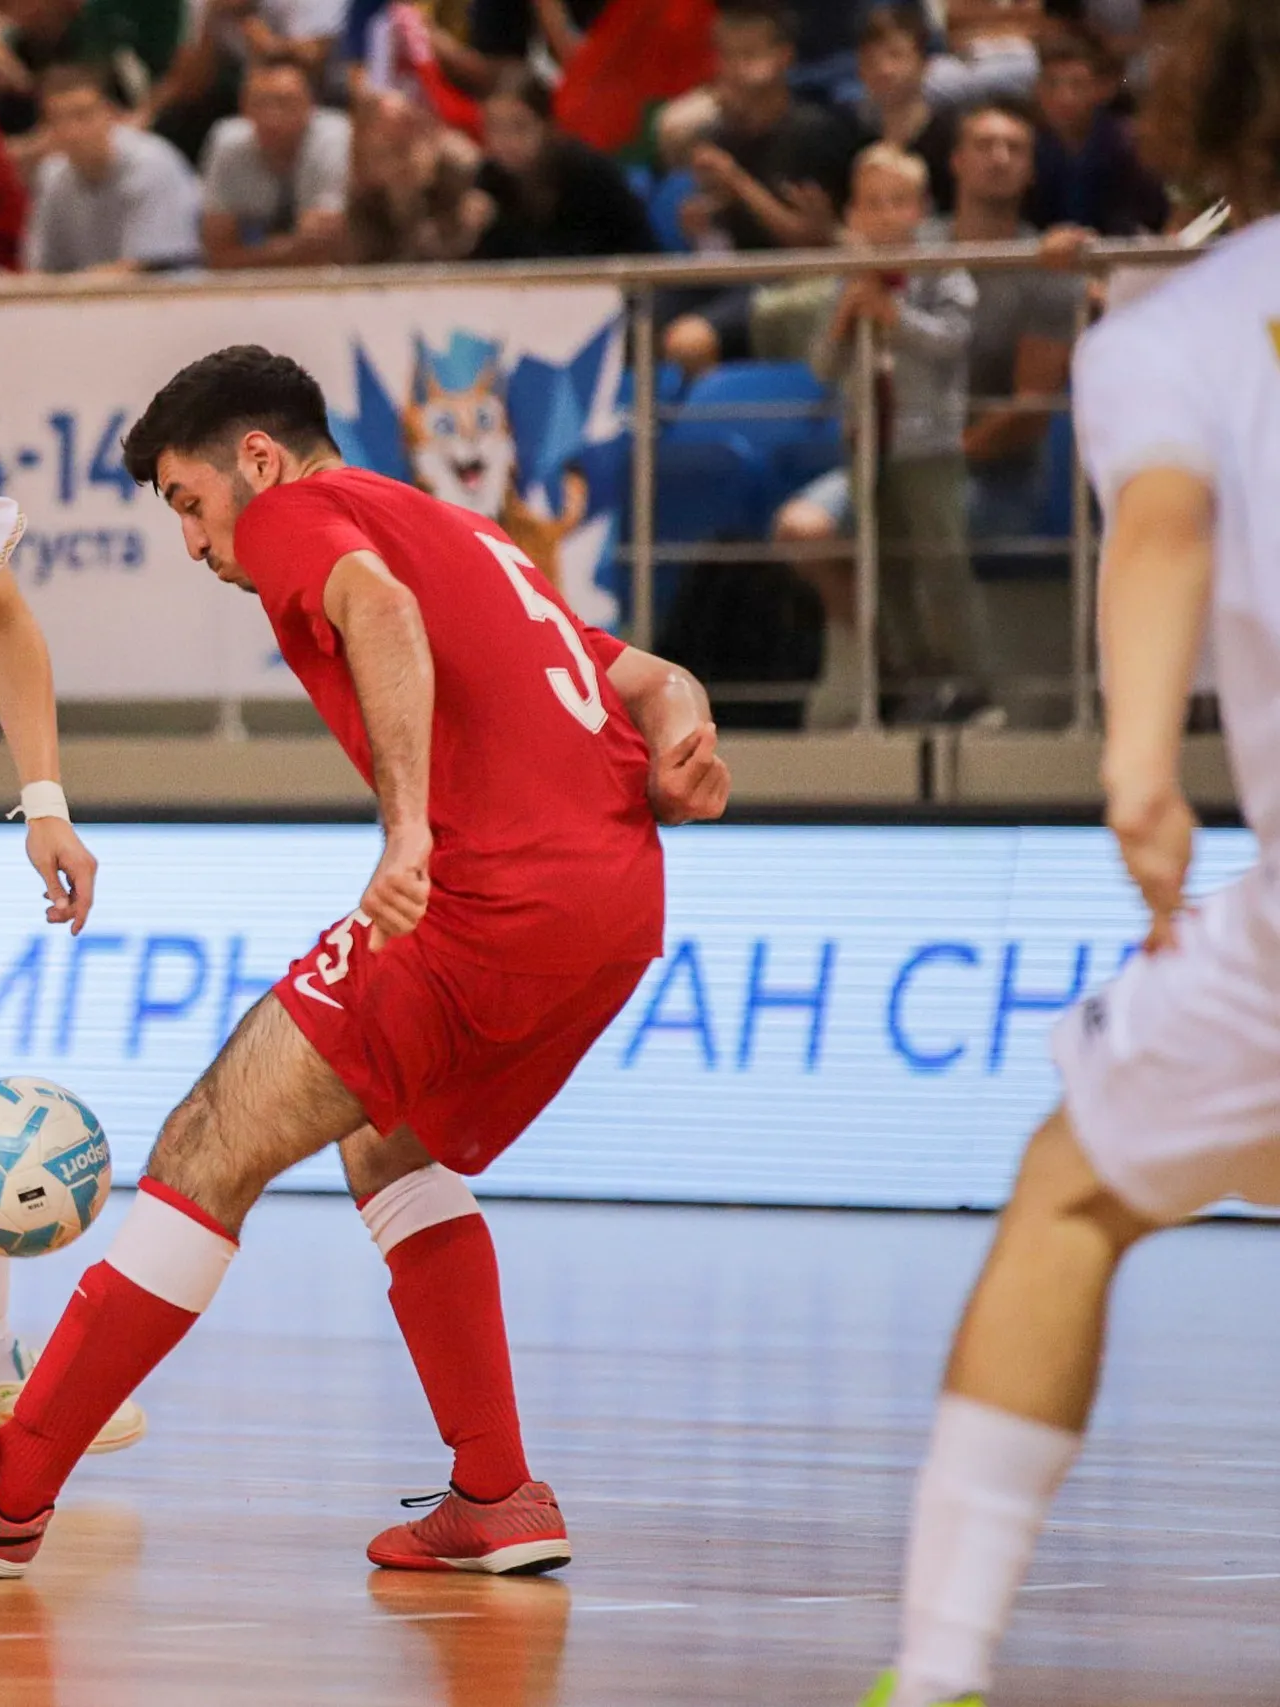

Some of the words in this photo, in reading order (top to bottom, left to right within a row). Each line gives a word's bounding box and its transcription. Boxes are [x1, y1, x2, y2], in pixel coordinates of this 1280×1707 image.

[474, 531, 609, 734] 5
[316, 907, 373, 986] 5
[886, 938, 1140, 1076] СН
